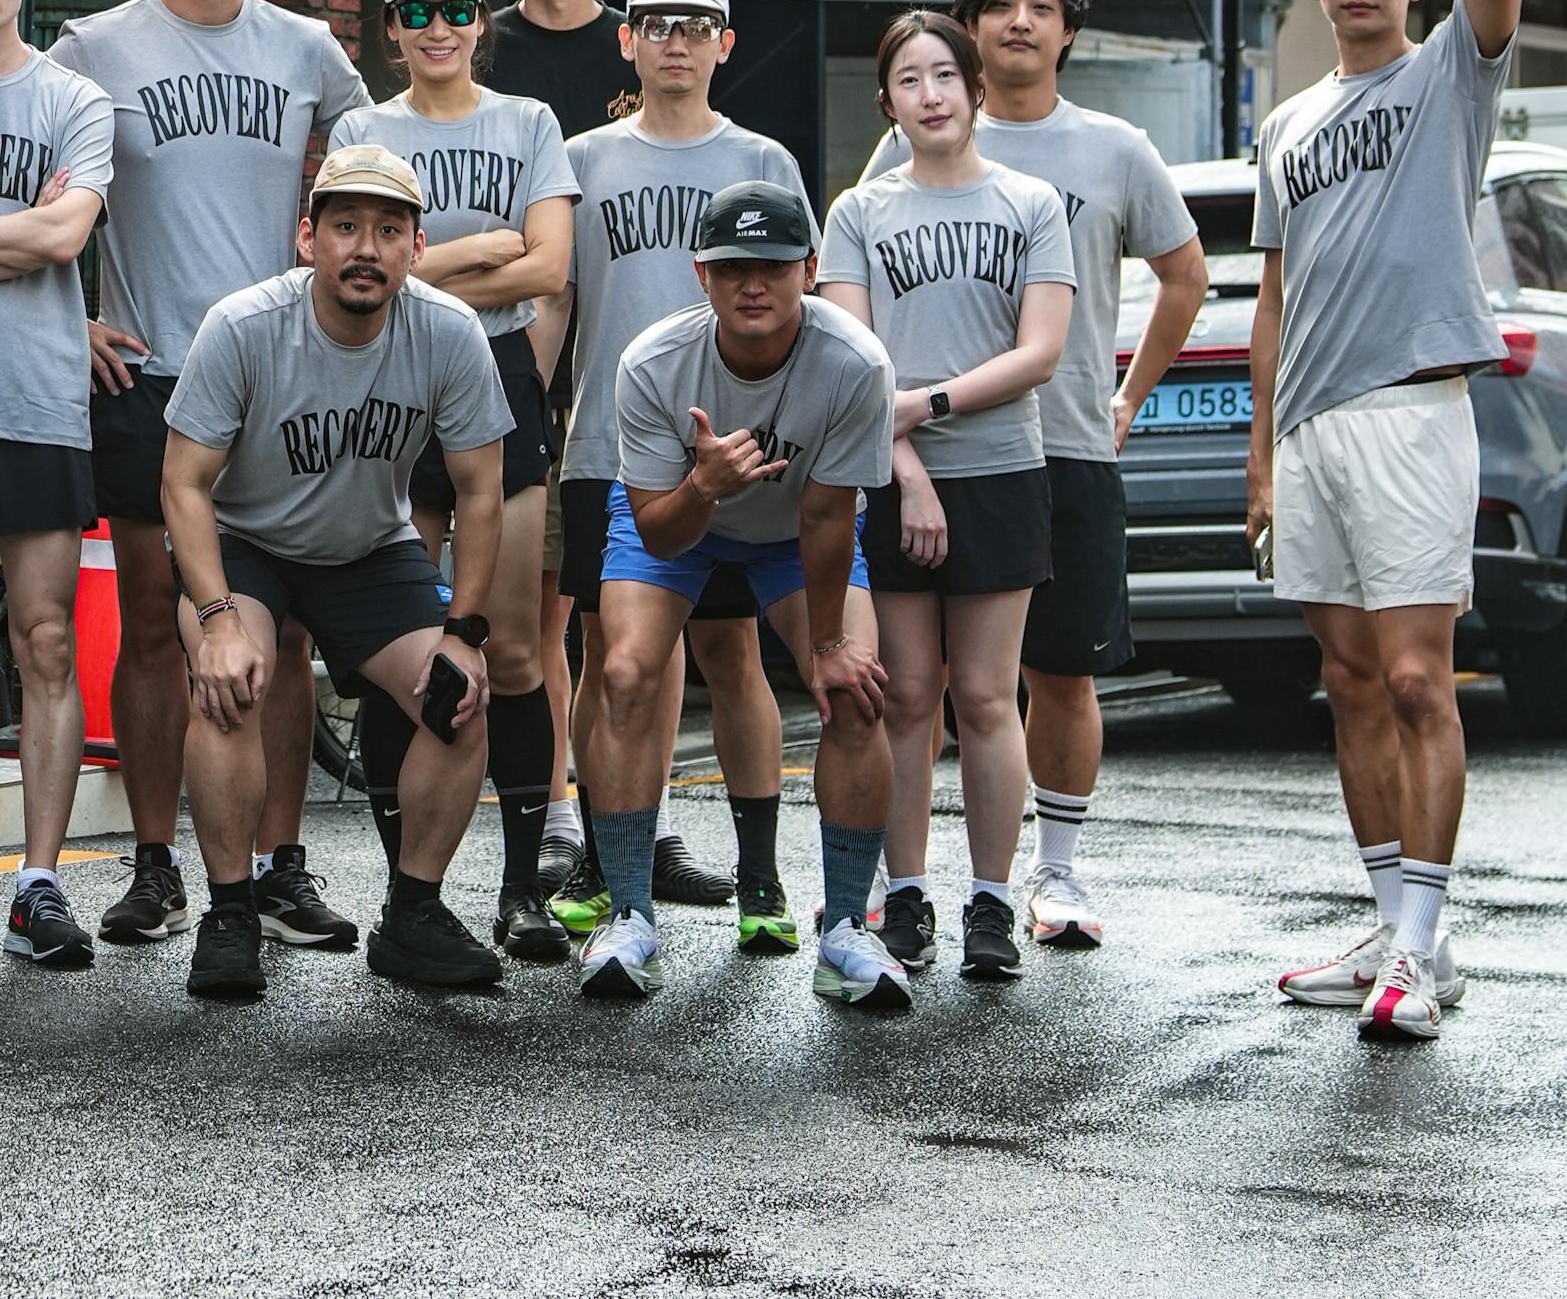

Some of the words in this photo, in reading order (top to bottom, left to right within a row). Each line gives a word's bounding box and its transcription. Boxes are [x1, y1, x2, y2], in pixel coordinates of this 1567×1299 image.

[137, 73, 290, 148] RECOVERY
[401, 149, 524, 222] COVERY
[741, 211, 763, 222] NIKE
[600, 185, 714, 262] RECOVE
[875, 220, 1028, 301] RECOVERY
